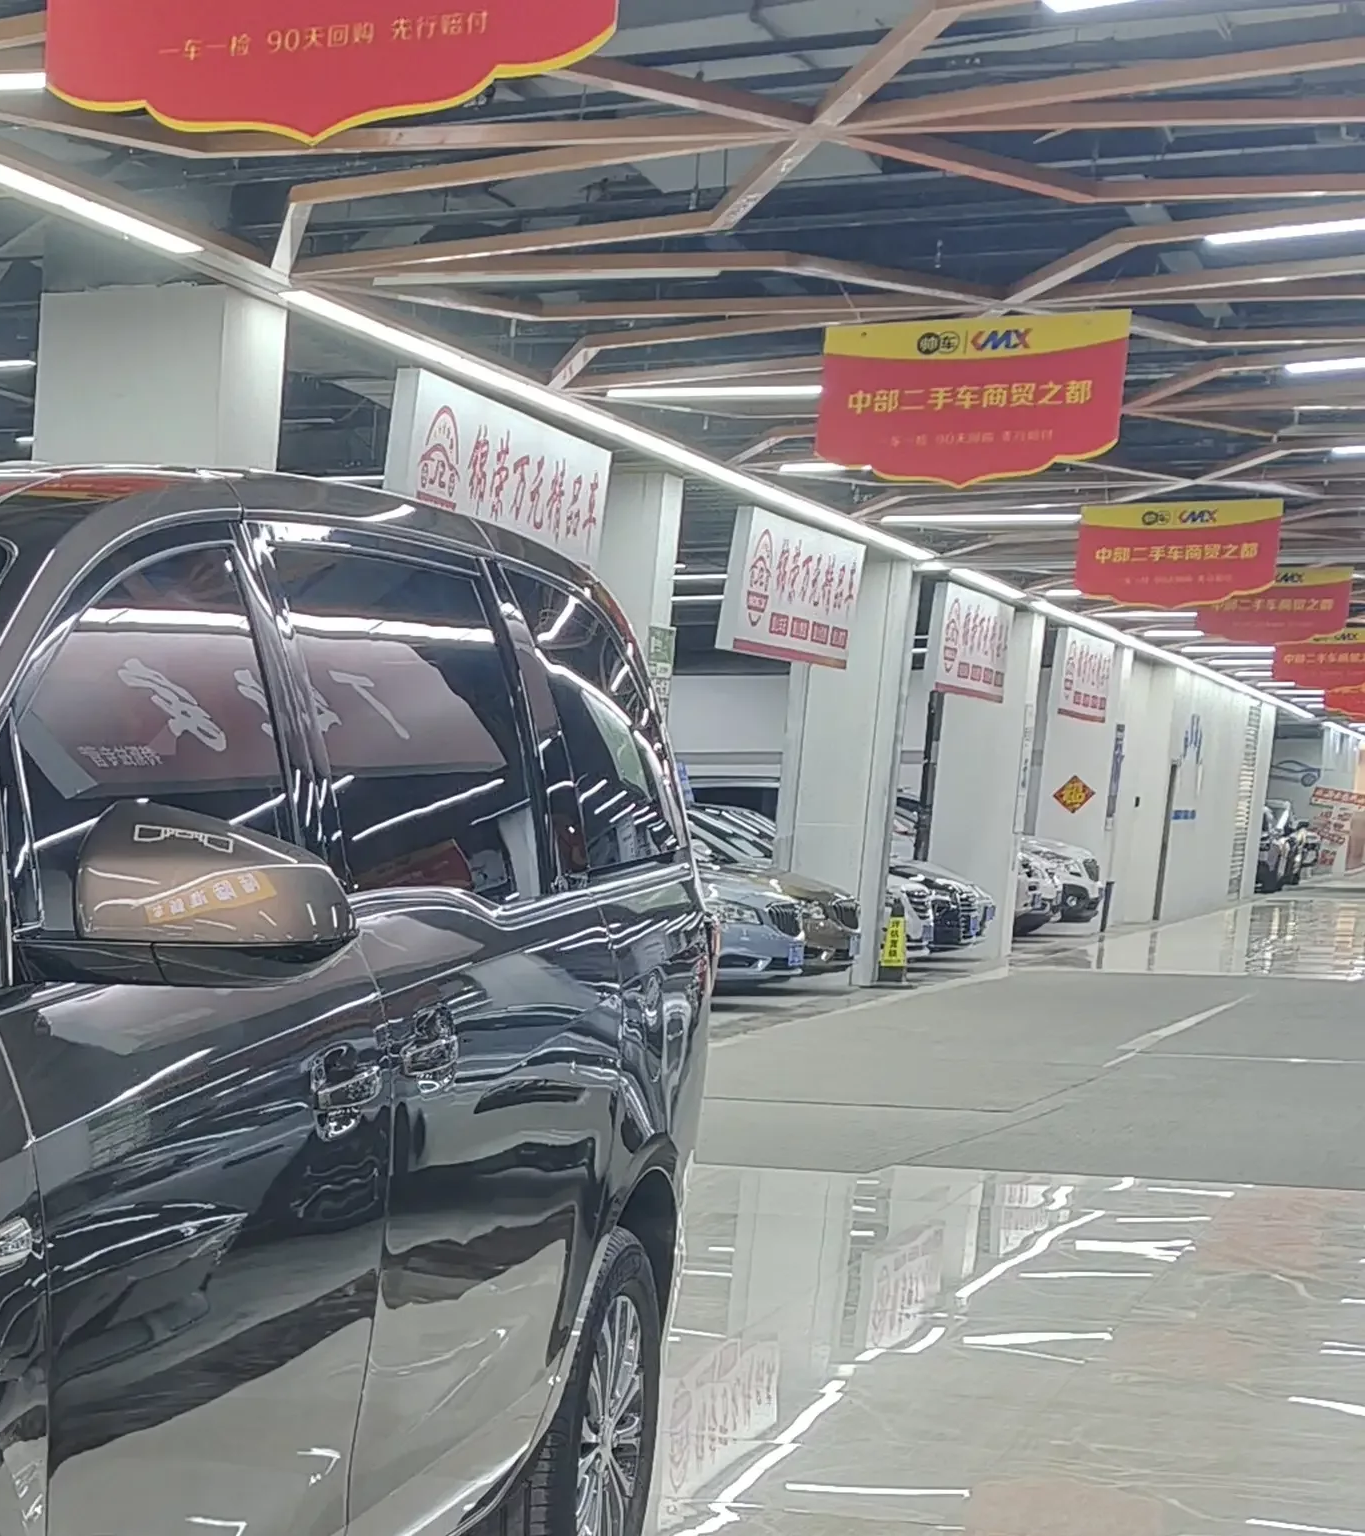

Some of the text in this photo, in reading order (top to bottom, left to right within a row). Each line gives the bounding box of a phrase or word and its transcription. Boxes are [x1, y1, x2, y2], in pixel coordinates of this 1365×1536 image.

[158, 10, 490, 61] 一车一检 90天回购 先行赔付
[847, 379, 1093, 415] 中部二手车商贸之都
[1095, 542, 1259, 565] 中部二手车商贸之都
